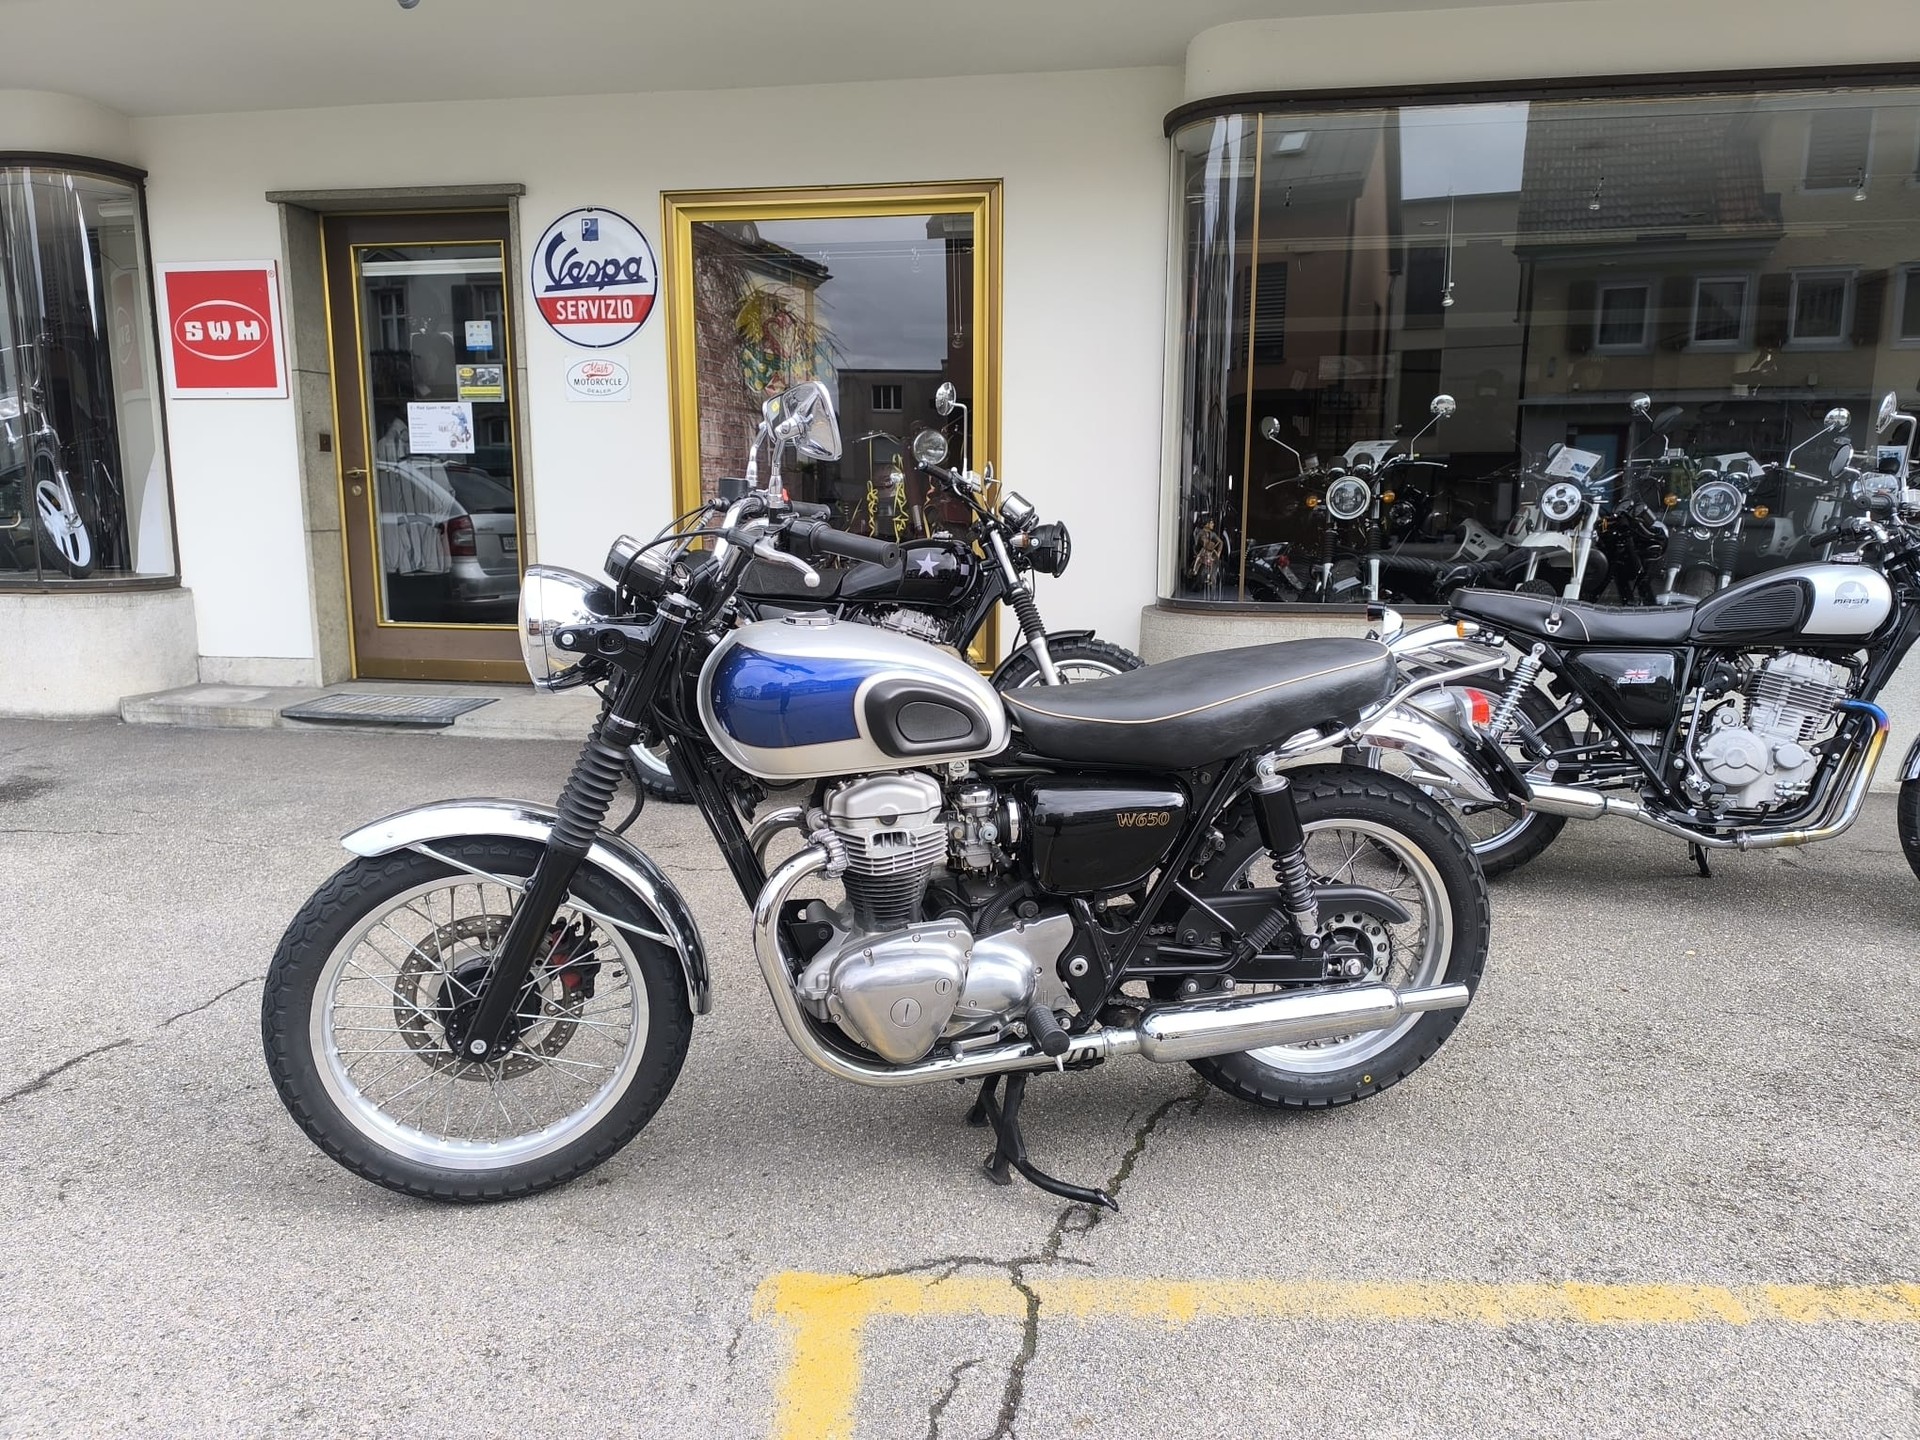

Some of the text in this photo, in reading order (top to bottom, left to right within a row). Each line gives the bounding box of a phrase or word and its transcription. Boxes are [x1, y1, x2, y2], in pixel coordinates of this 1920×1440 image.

[544, 231, 648, 292] Vespa
[556, 299, 633, 320] SERVIZIO
[184, 320, 261, 341] SWM
[573, 378, 622, 386] MOTORCYCLE
[1117, 812, 1170, 827] W650
